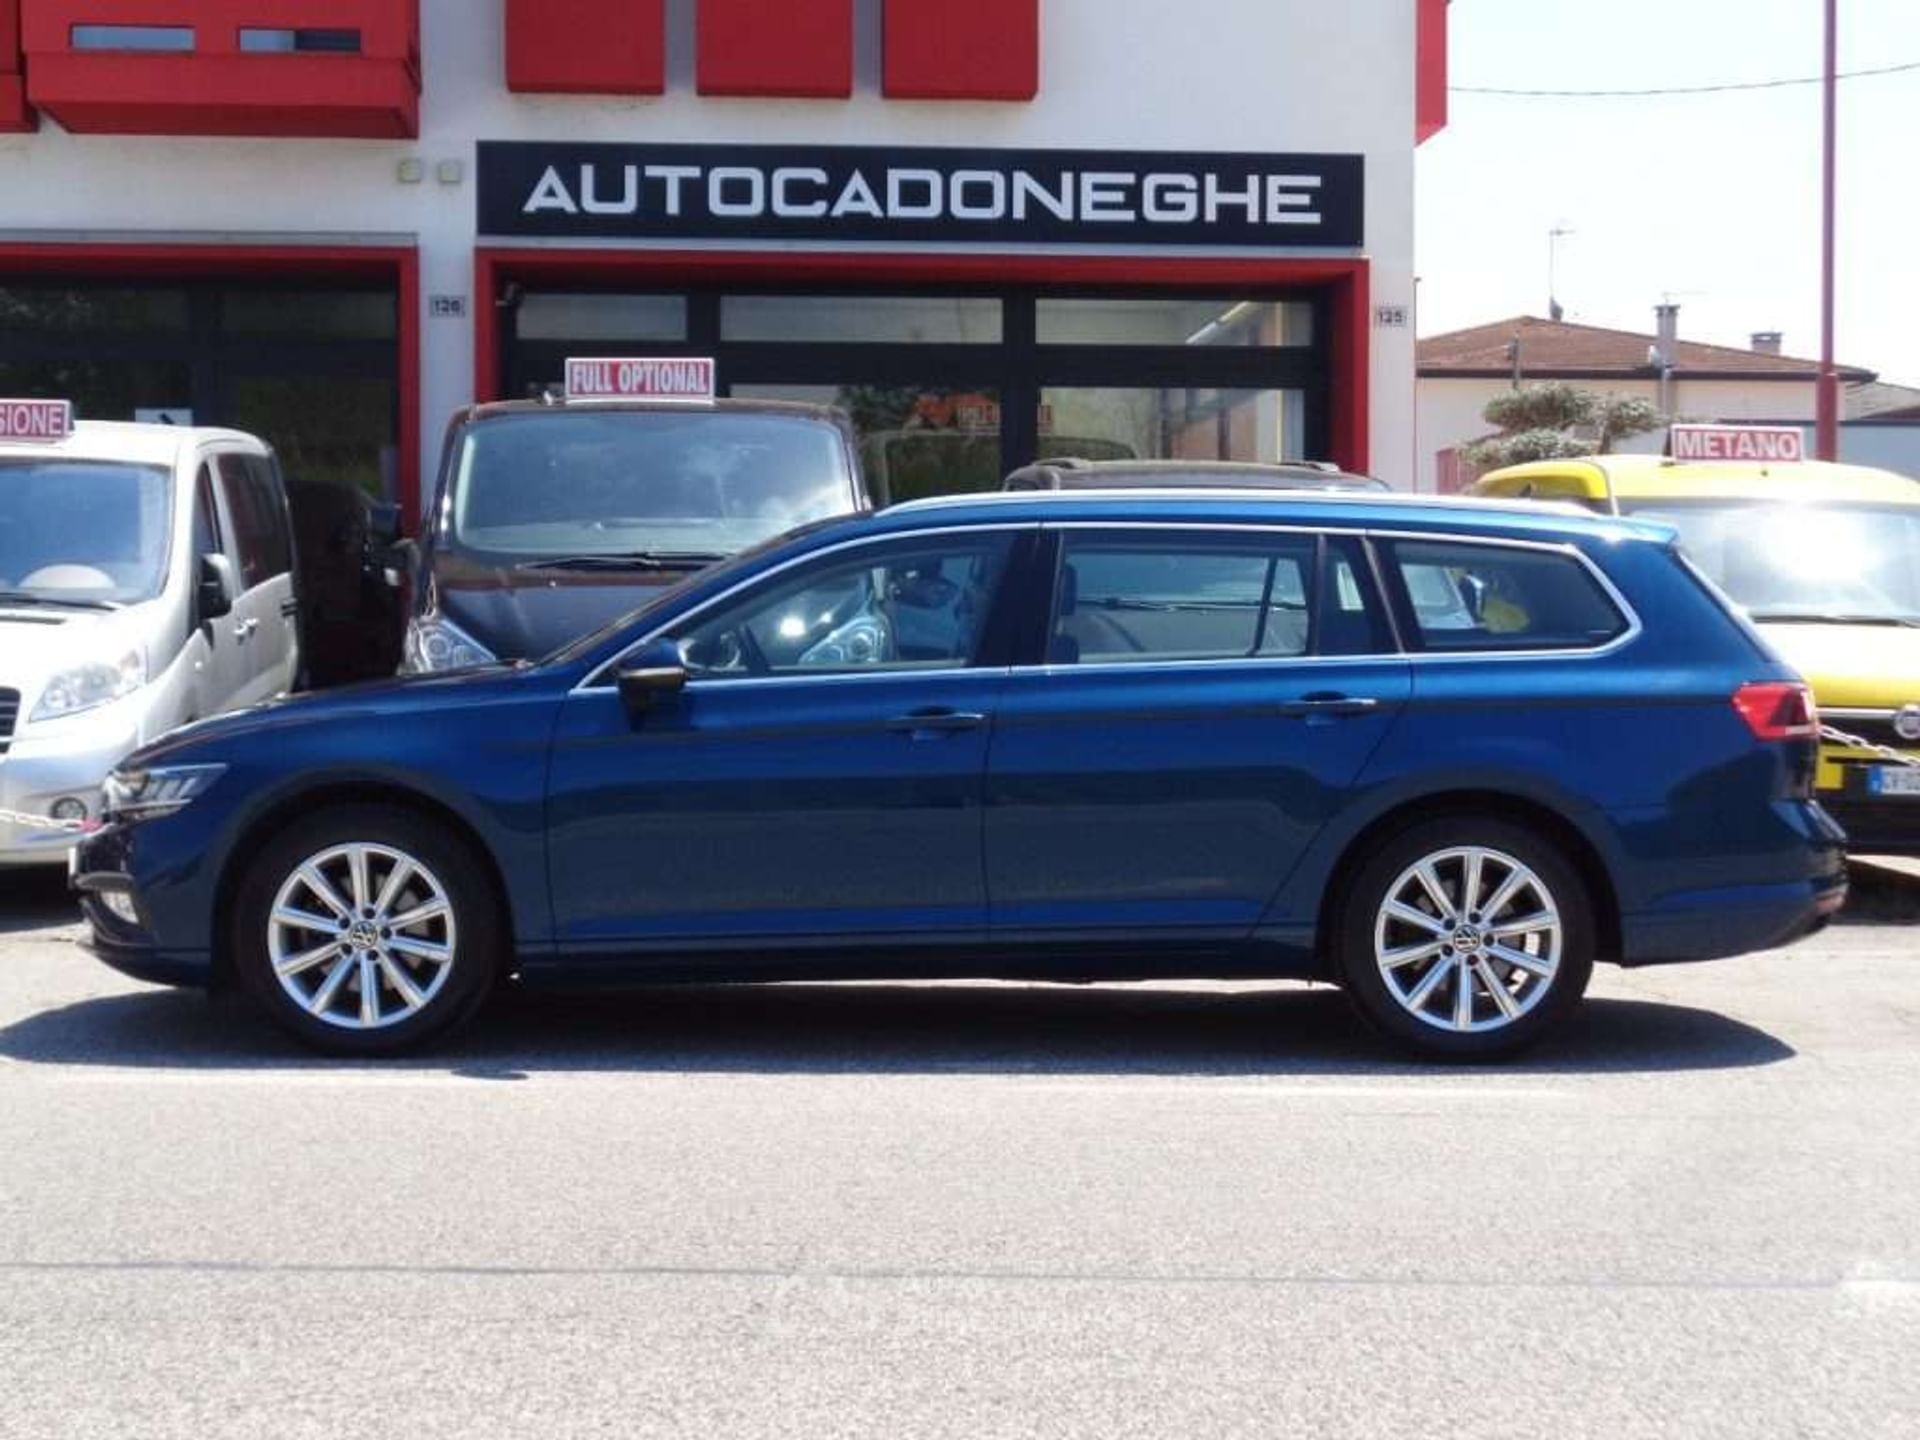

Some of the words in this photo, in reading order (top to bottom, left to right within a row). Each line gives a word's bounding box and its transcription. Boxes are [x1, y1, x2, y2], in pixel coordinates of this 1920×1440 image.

[522, 164, 1321, 224] AUTOCADONEGHE
[572, 363, 612, 392] FULL
[618, 363, 708, 392] OPTIONAL
[1679, 430, 1798, 459] METANO
